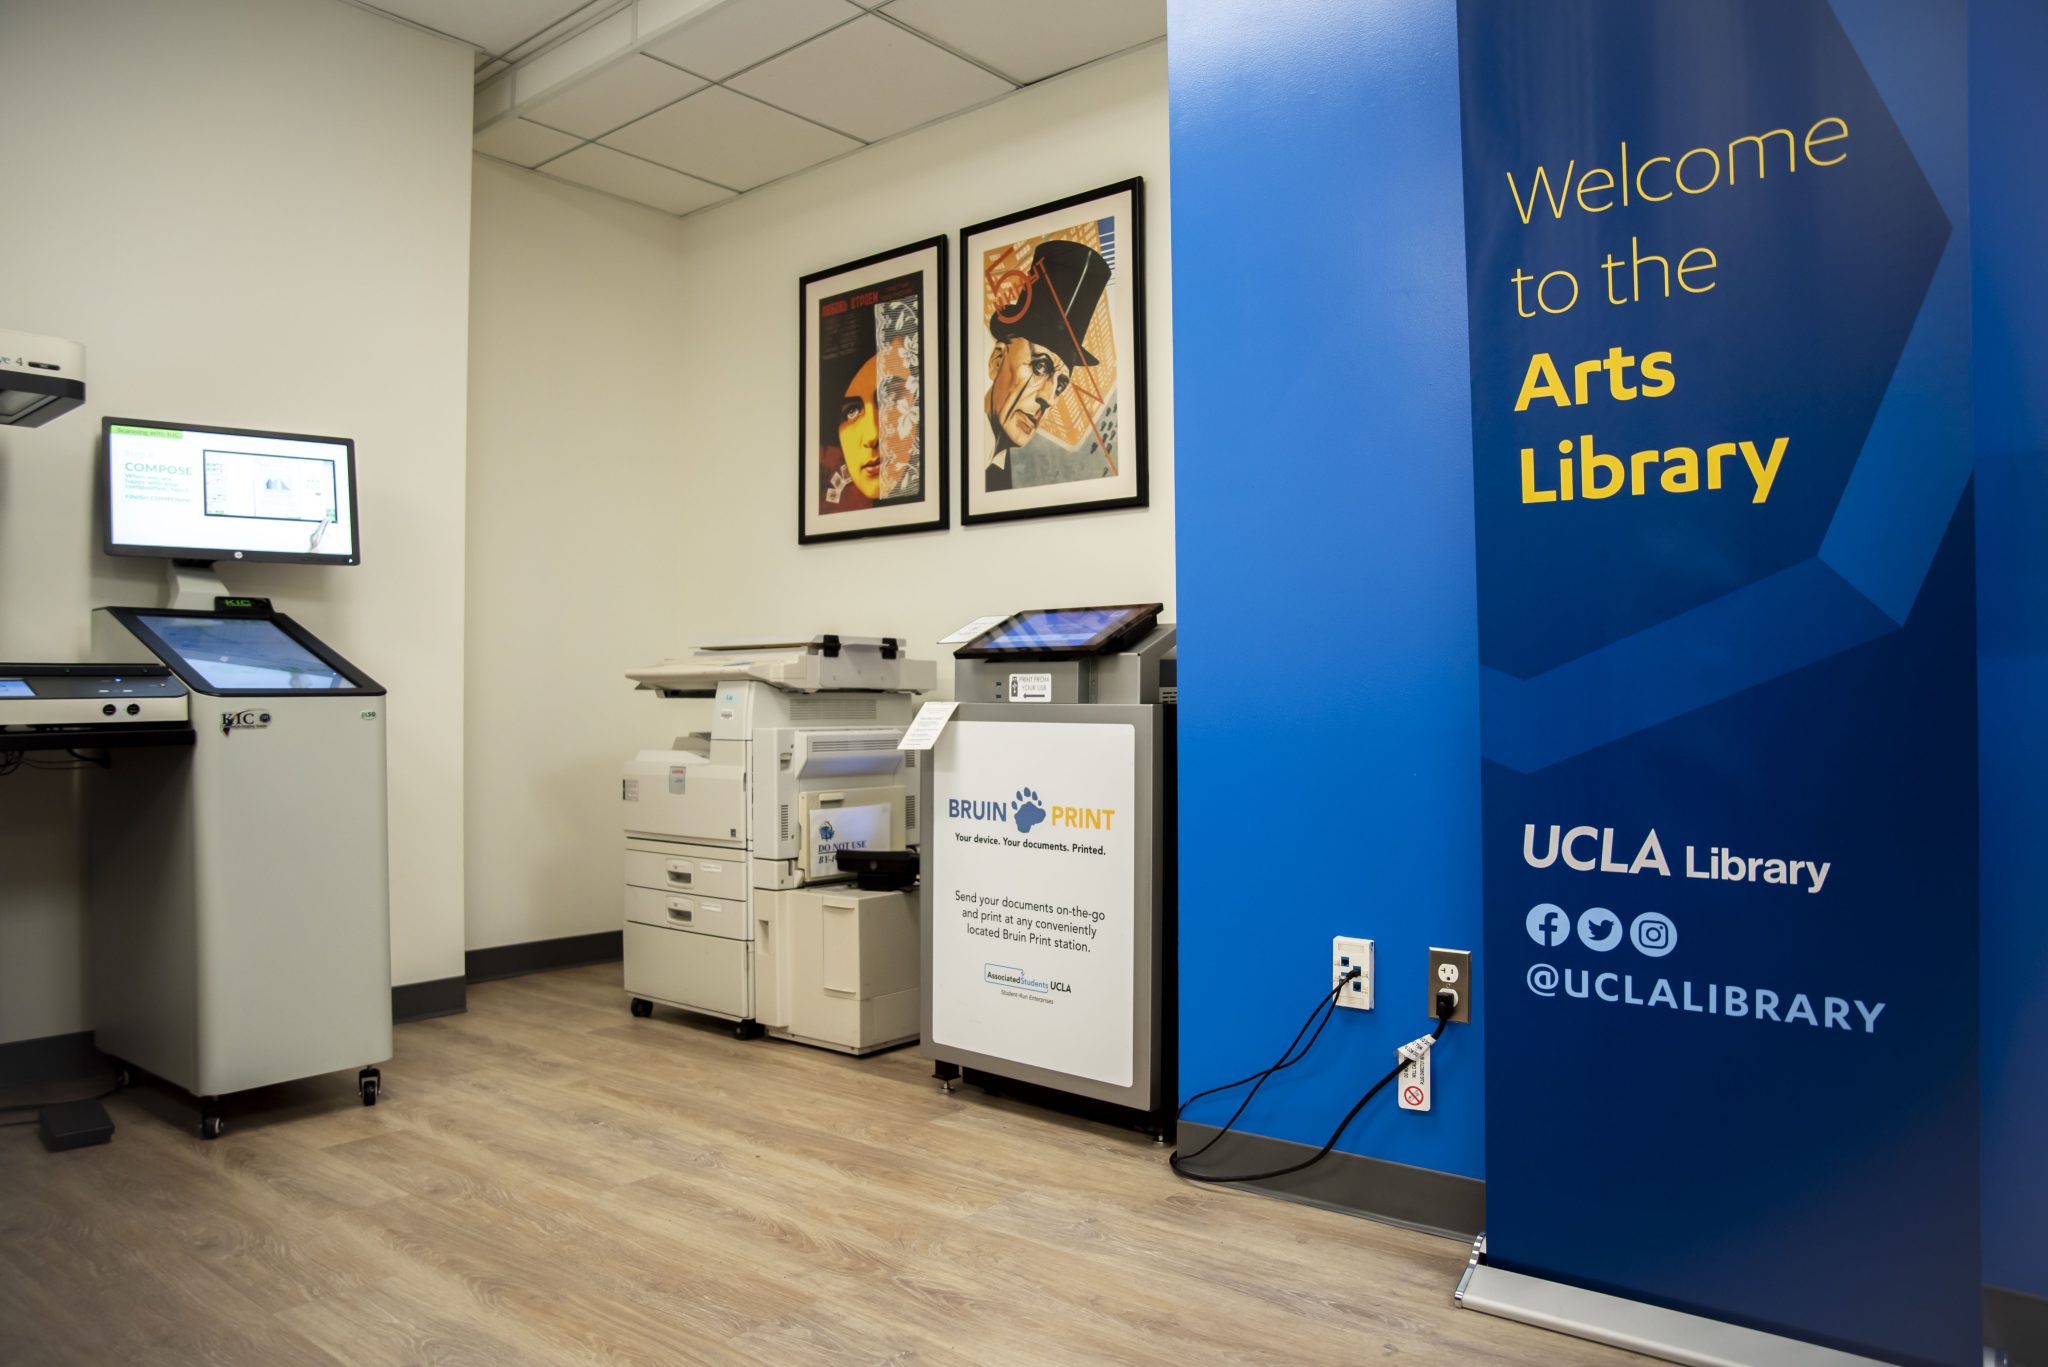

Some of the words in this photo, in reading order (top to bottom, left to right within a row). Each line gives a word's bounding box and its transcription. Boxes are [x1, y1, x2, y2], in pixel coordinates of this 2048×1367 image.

[1506, 116, 1849, 225] Welcome
[1510, 267, 1580, 318] to
[1600, 236, 1718, 306] the
[1513, 346, 1676, 412] Arts
[124, 461, 192, 477] COMPOSE
[1519, 434, 1791, 505] Library
[224, 599, 252, 607] KIC
[1018, 676, 1033, 684] PRINT
[1034, 676, 1050, 684] FROM
[1021, 684, 1036, 692] YOUR
[221, 712, 255, 725] KIC
[948, 798, 1007, 822] BRUIN
[1051, 805, 1116, 831] PRINT
[818, 844, 831, 853] DO
[832, 841, 850, 850] NOT
[851, 840, 867, 849] USE
[955, 832, 972, 842] Your
[973, 835, 1001, 845] device.
[1002, 837, 1021, 847] Your
[1022, 839, 1070, 852] documents.
[1072, 843, 1107, 856] Printed.
[1522, 823, 1672, 877] UCLA
[1686, 845, 1831, 894] Library
[955, 889, 977, 903] Send
[979, 895, 1000, 907] your
[1001, 896, 1054, 914] documents
[1056, 905, 1106, 923] on-the-go
[961, 908, 979, 920] and
[980, 911, 1002, 923] print
[1004, 914, 1014, 925] at
[1016, 917, 1033, 930] any
[1035, 921, 1098, 940] conveniently
[966, 923, 1000, 939] located
[1002, 928, 1027, 943] Bruin
[1029, 932, 1052, 948] Print
[1054, 938, 1092, 953] station.
[1050, 981, 1072, 993] UCLA
[1526, 962, 1887, 1035] @UCLALIBRARY
